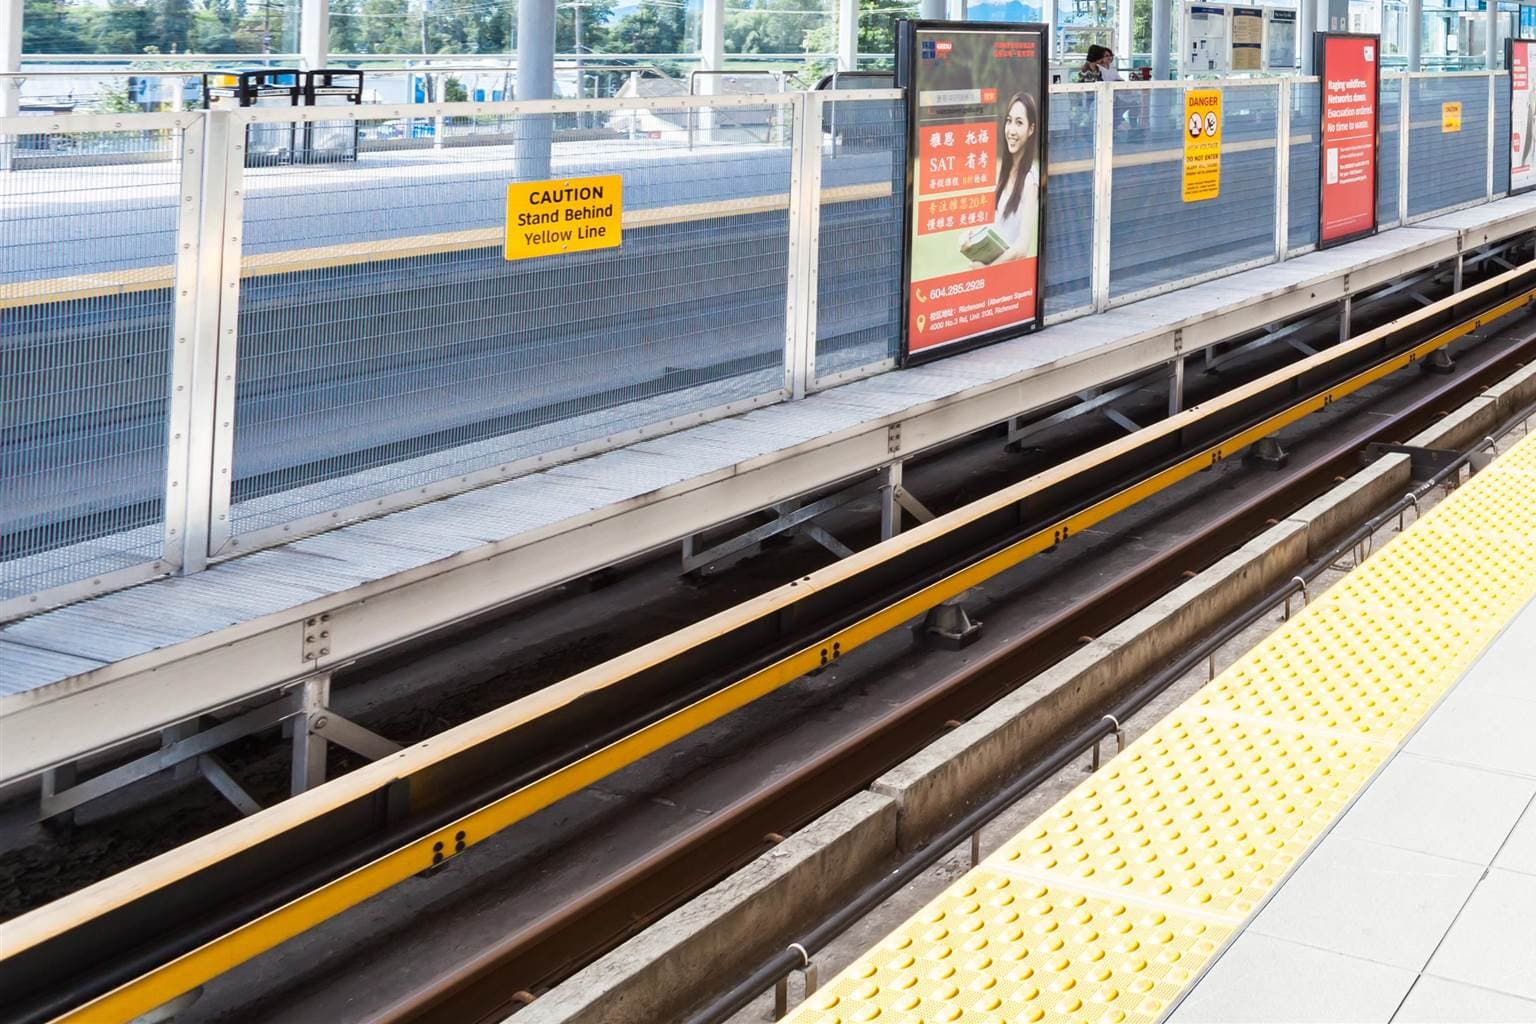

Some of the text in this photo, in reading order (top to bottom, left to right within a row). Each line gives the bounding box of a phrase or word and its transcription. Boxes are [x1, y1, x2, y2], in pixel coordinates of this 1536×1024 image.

[1327, 80, 1346, 92] Raging
[1189, 97, 1218, 106] DANGER
[1327, 95, 1352, 104] Networks
[1327, 108, 1355, 118] Evacuation
[1327, 123, 1336, 132] No
[1336, 122, 1348, 131] time
[1348, 122, 1354, 130] to
[965, 129, 990, 145] 托福
[930, 156, 956, 172] SAT
[529, 186, 603, 205] CAUTION
[518, 204, 613, 226] Stand Behind
[525, 225, 606, 245] Yellow Line
[959, 302, 985, 313] Richmond
